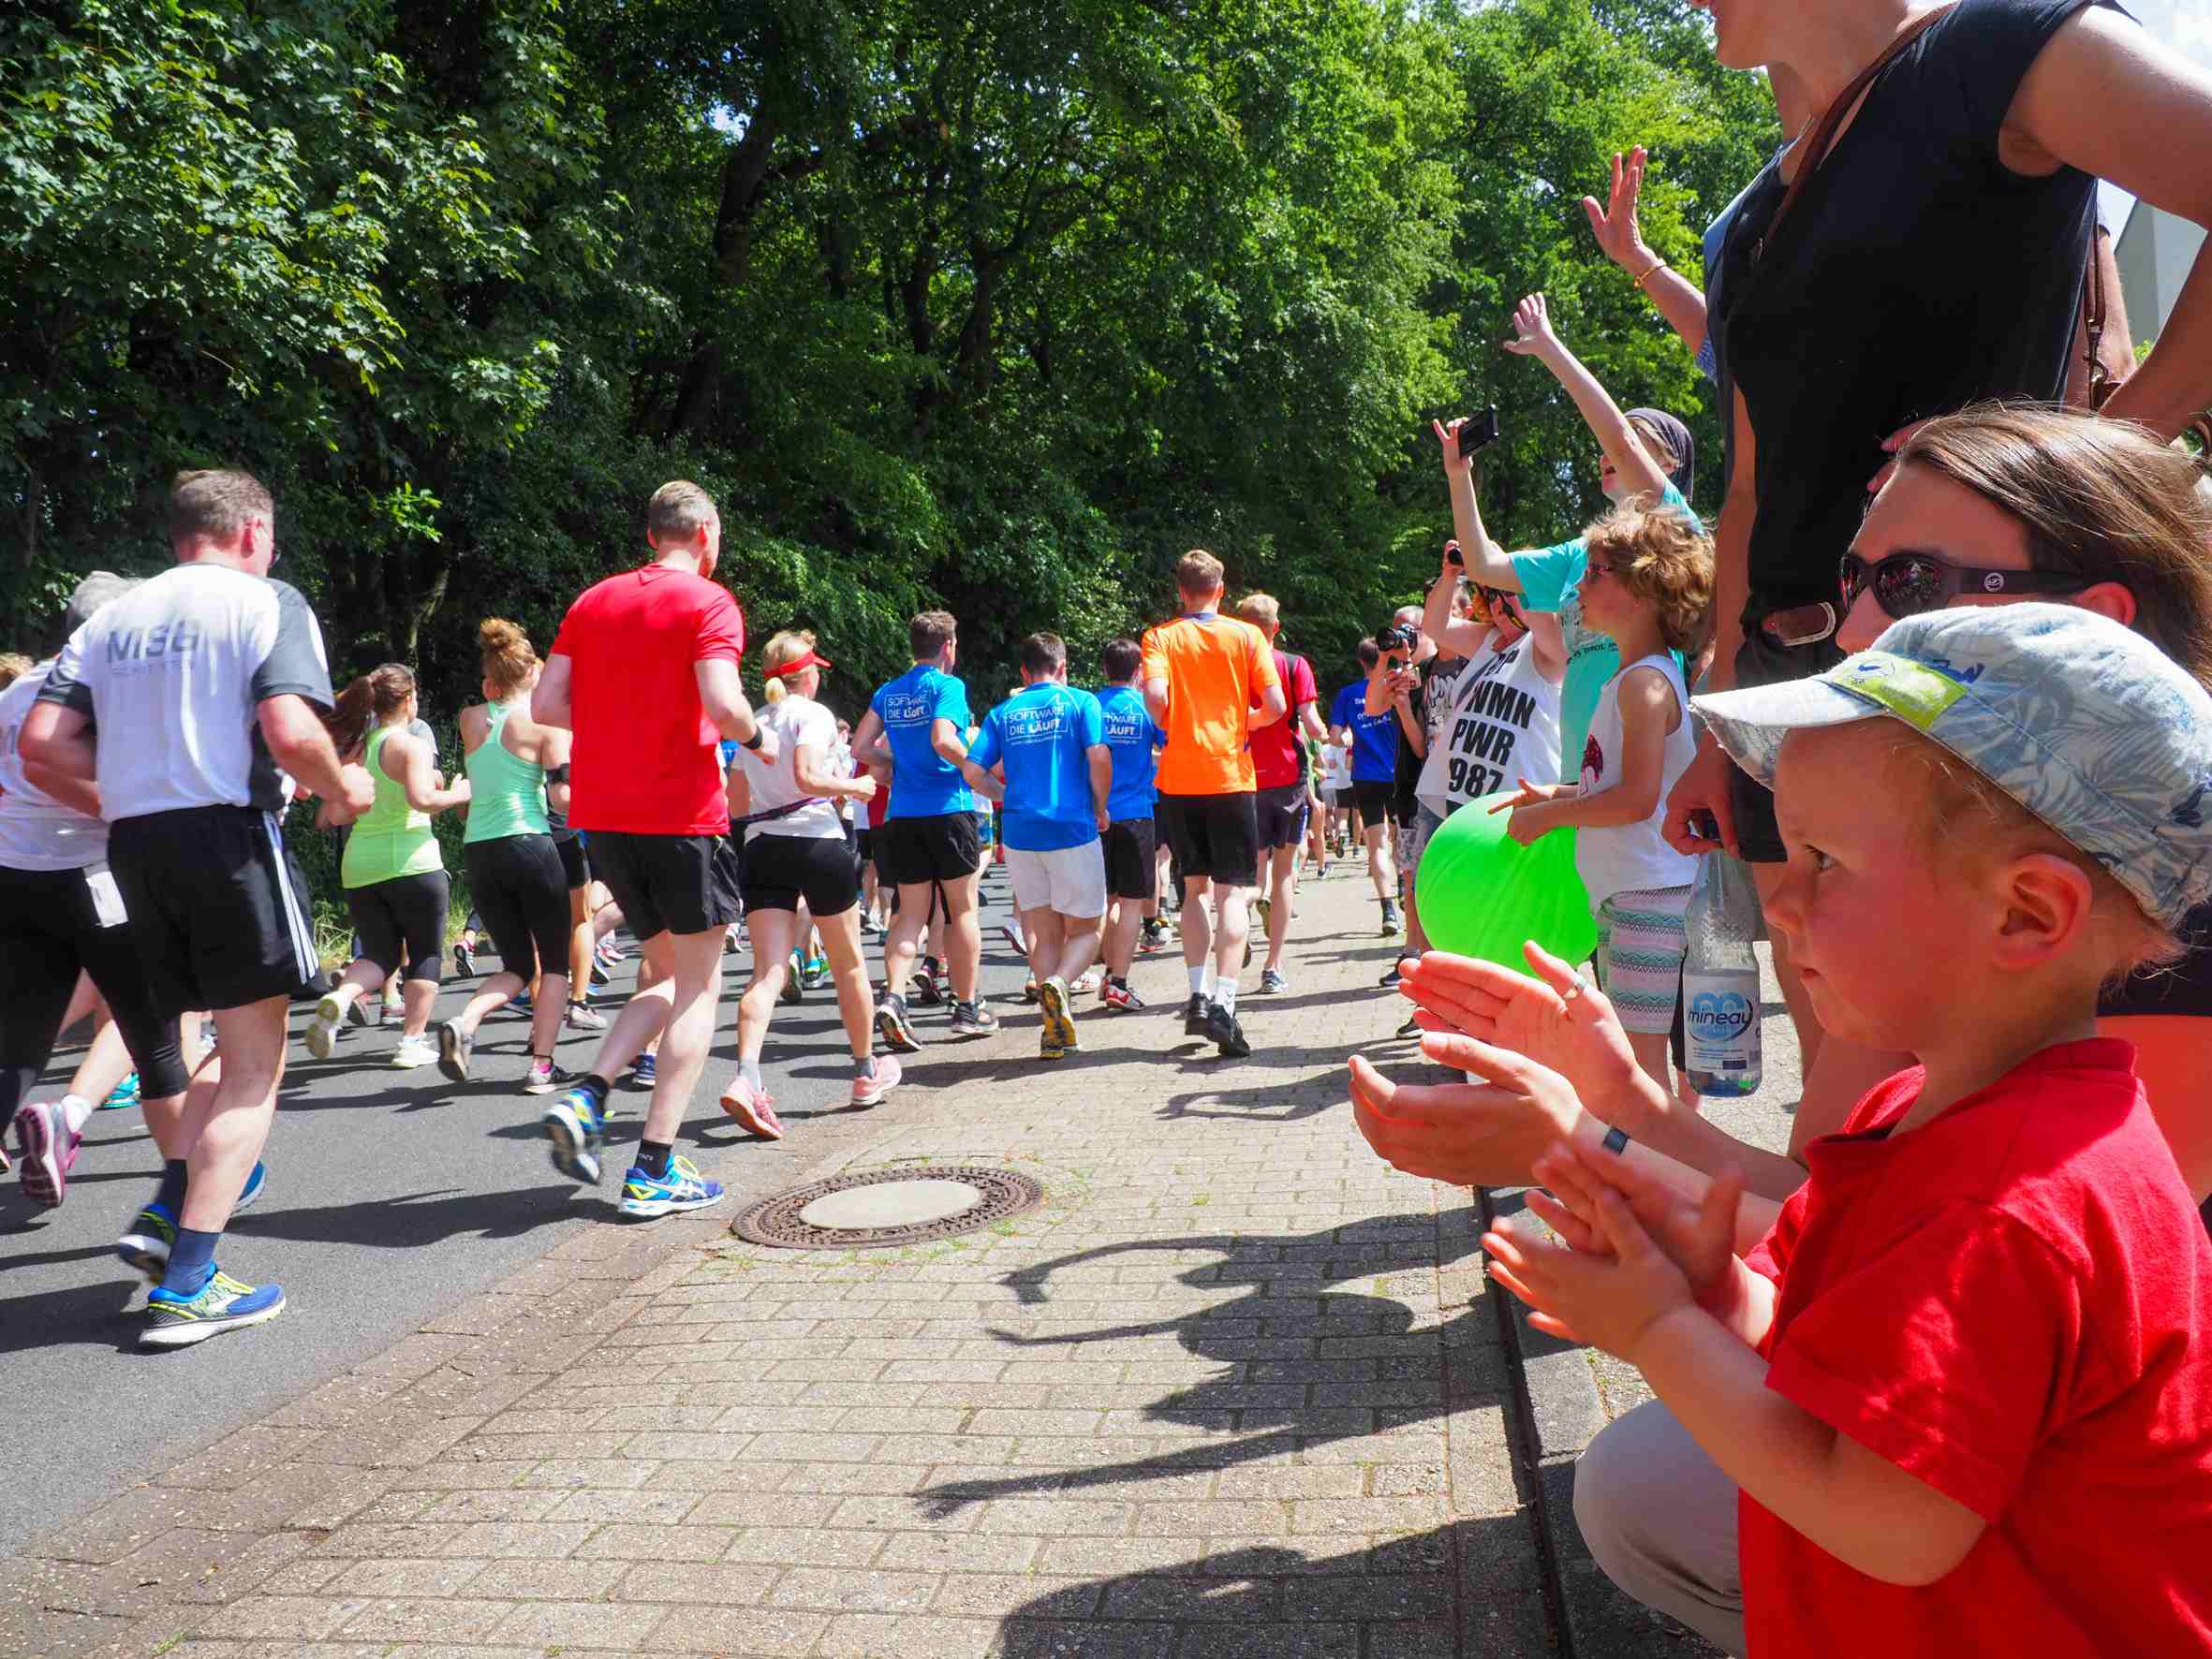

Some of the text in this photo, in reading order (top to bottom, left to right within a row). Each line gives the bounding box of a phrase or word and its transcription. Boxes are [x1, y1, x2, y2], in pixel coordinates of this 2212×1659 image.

[888, 709, 901, 719] DIE
[1010, 718, 1061, 736] DIE LÄUFT
[1449, 718, 1515, 766] PWR
